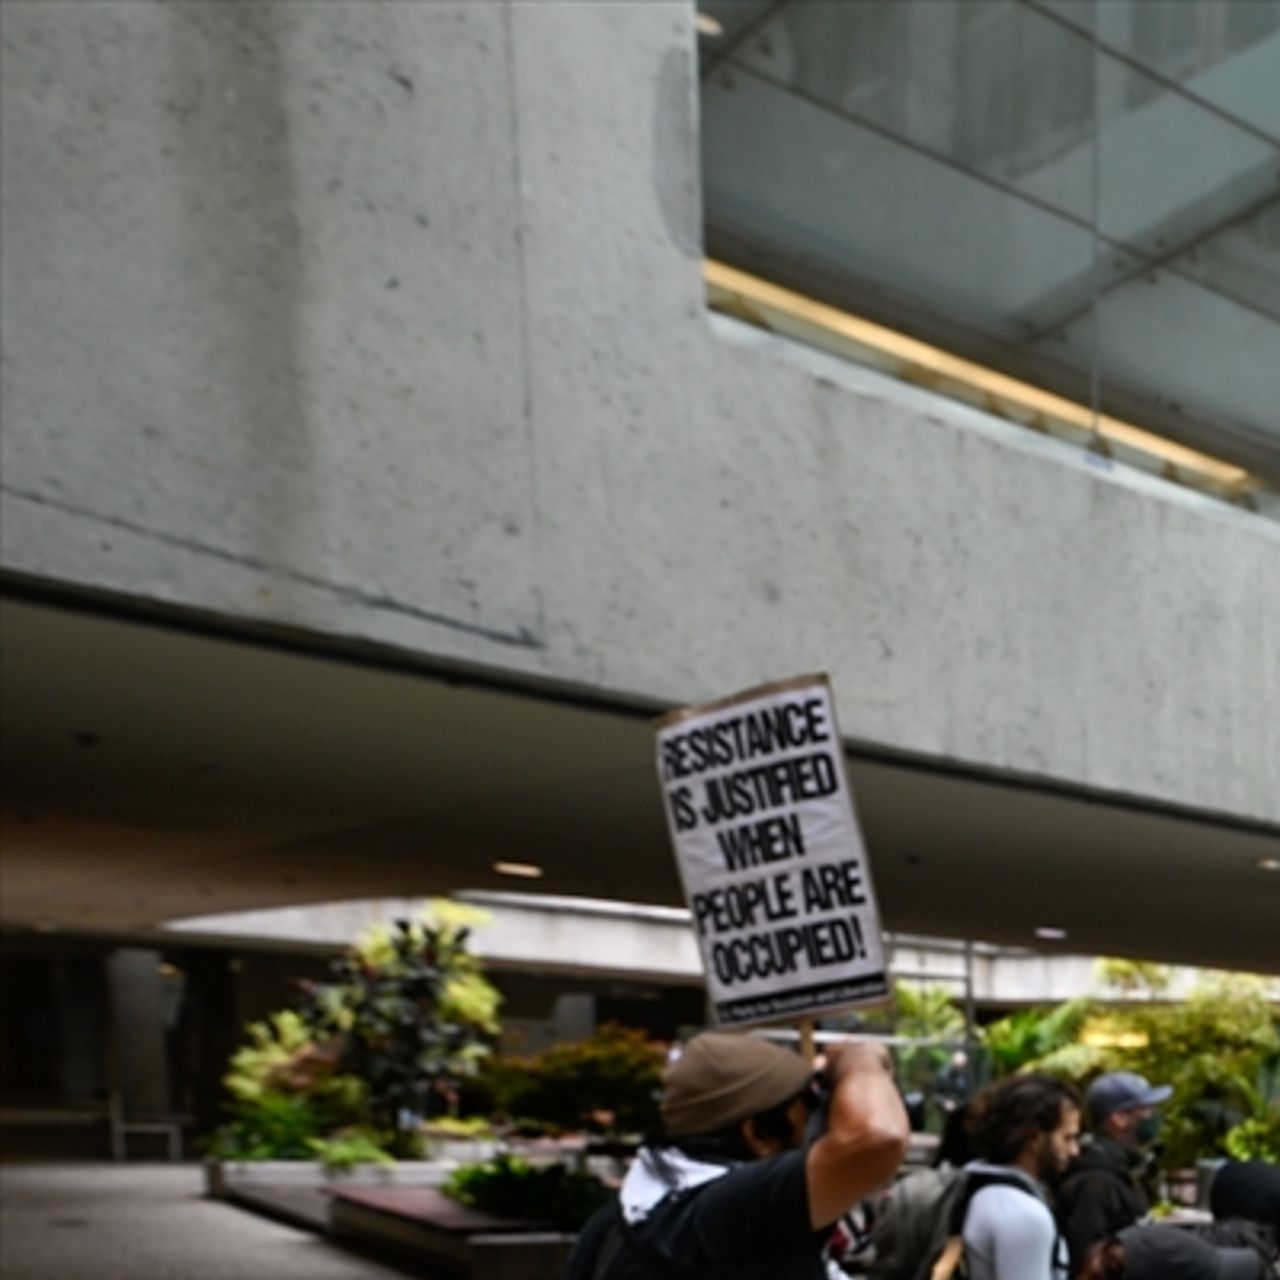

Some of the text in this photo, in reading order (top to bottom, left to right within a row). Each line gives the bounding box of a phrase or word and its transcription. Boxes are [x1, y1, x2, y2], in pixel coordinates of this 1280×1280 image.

[661, 698, 830, 783] RESISTANCE
[669, 752, 839, 833] IS JUSTIFIED
[716, 813, 806, 873] WHEN
[693, 859, 867, 938] PEOPLE ARE
[711, 914, 868, 987] OCCUPIED!
